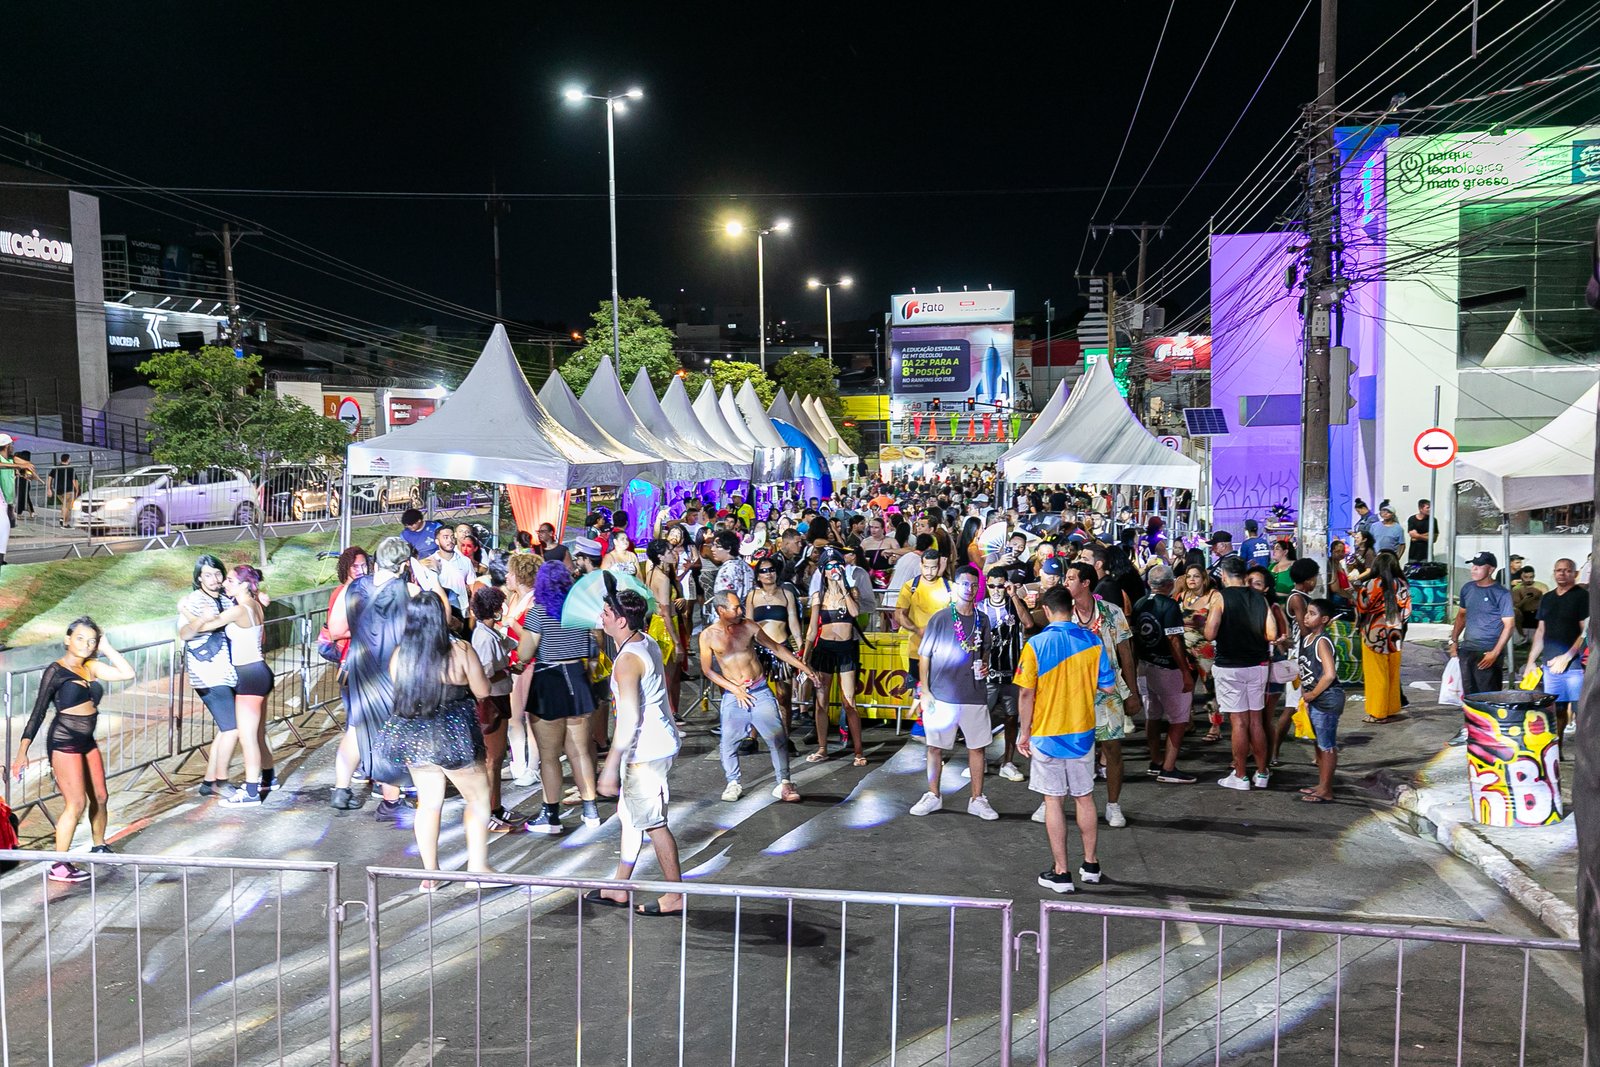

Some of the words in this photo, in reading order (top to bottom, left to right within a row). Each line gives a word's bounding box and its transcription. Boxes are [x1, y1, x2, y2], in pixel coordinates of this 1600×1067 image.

[1428, 151, 1473, 163] parque
[1427, 177, 1460, 190] mato
[1463, 176, 1509, 190] grosso
[11, 229, 63, 262] ceico
[921, 302, 945, 313] Fato
[907, 345, 935, 354] EDUCAÇÃO
[902, 359, 914, 367] DA
[915, 367, 952, 377] POSIÇÃO
[855, 668, 914, 701] SKO
